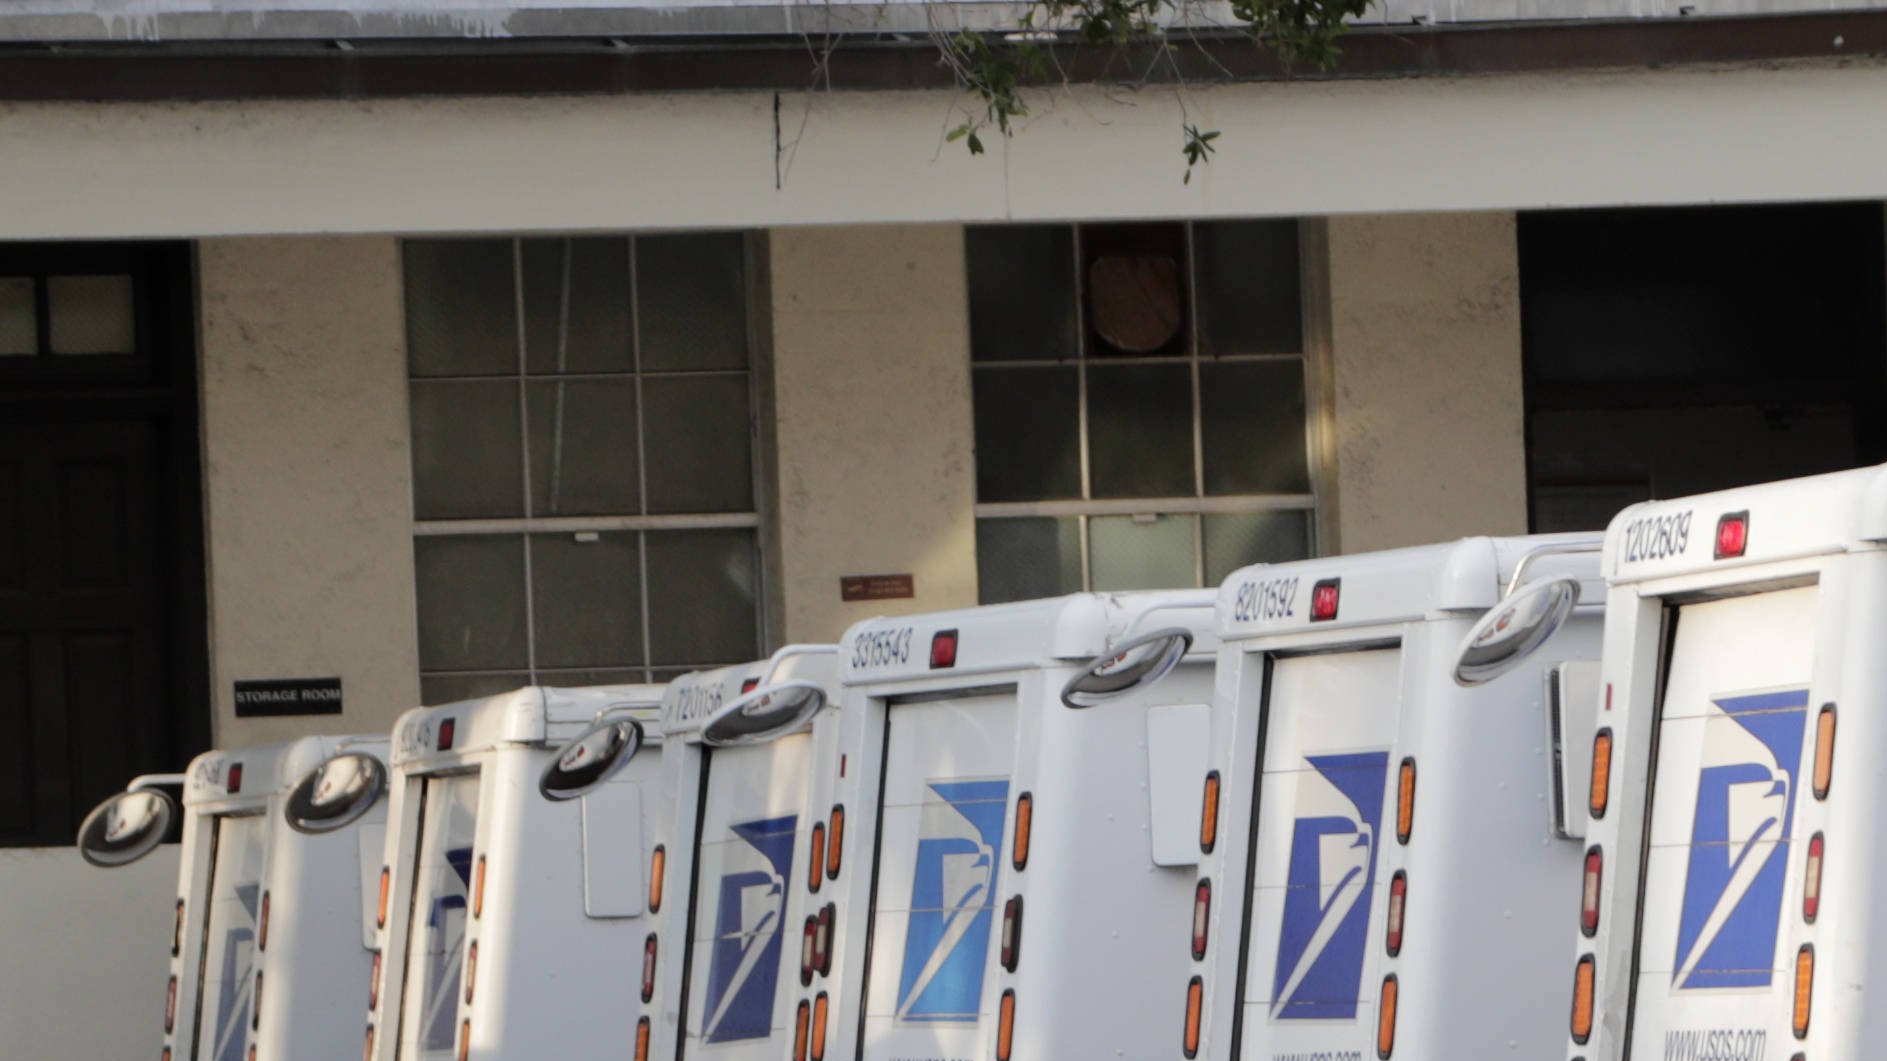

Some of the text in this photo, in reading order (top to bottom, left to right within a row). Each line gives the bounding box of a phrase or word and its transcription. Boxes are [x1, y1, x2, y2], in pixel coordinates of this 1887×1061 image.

[1625, 510, 1693, 563] 1202609
[851, 627, 913, 669] 3315543
[236, 688, 340, 703] STORAGE ROOM
